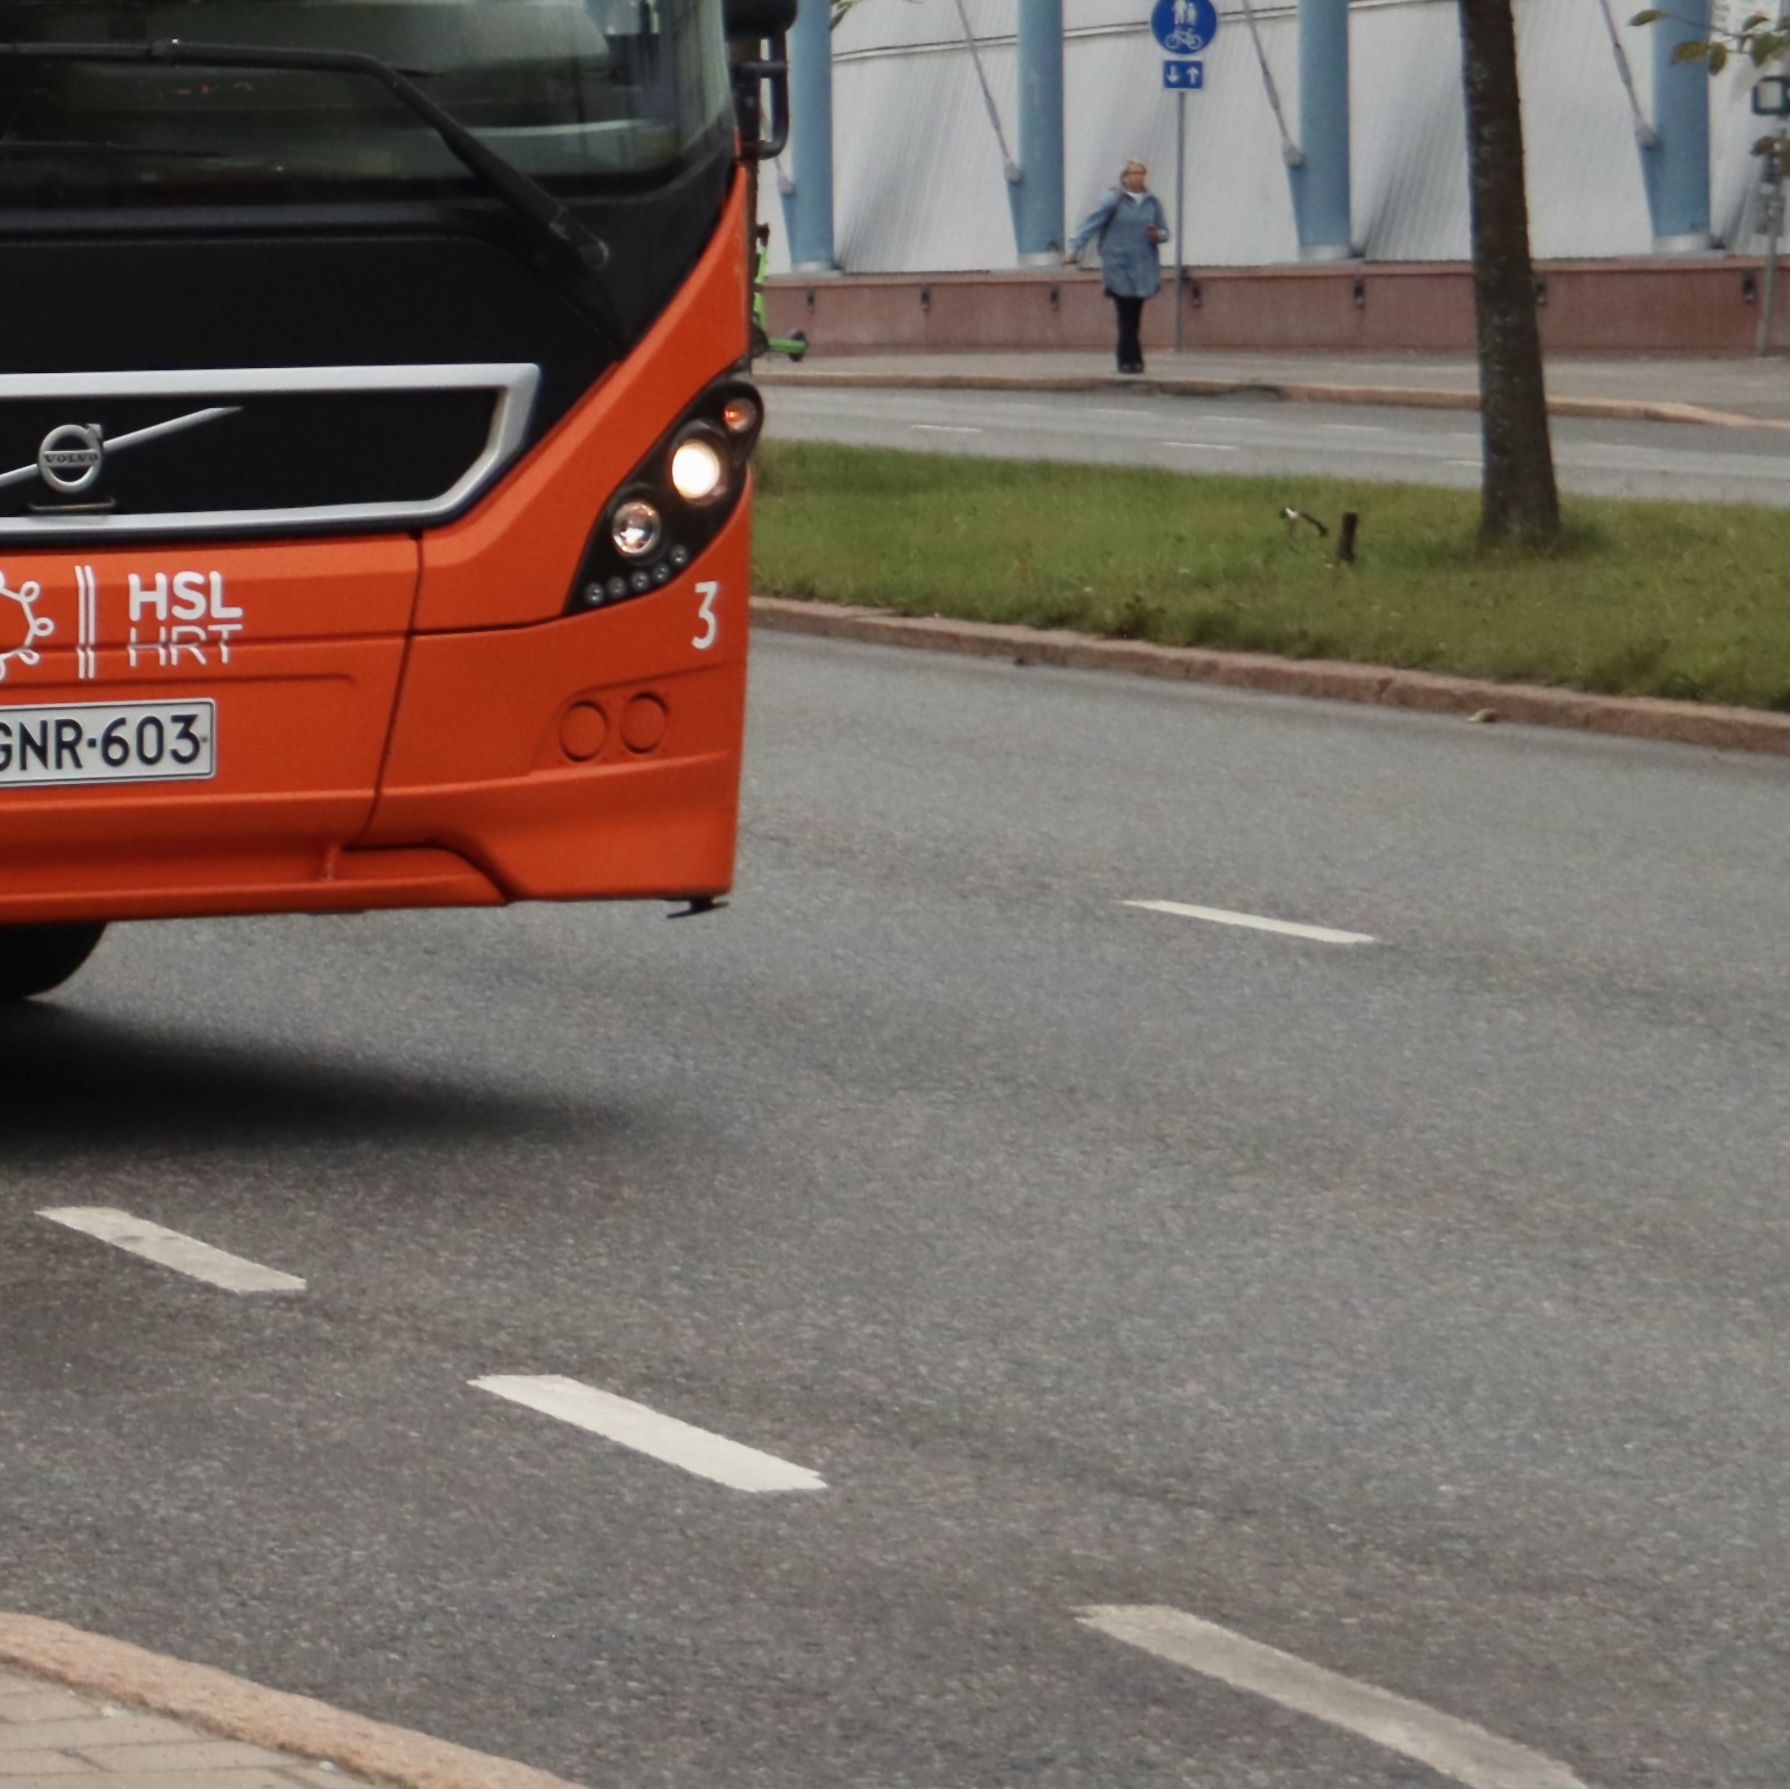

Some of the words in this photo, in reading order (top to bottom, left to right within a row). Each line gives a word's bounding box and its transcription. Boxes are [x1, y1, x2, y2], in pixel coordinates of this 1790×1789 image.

[42, 452, 99, 465] VOLVO
[127, 570, 244, 622] HSL
[691, 581, 719, 649] 3
[127, 623, 244, 667] HRT
